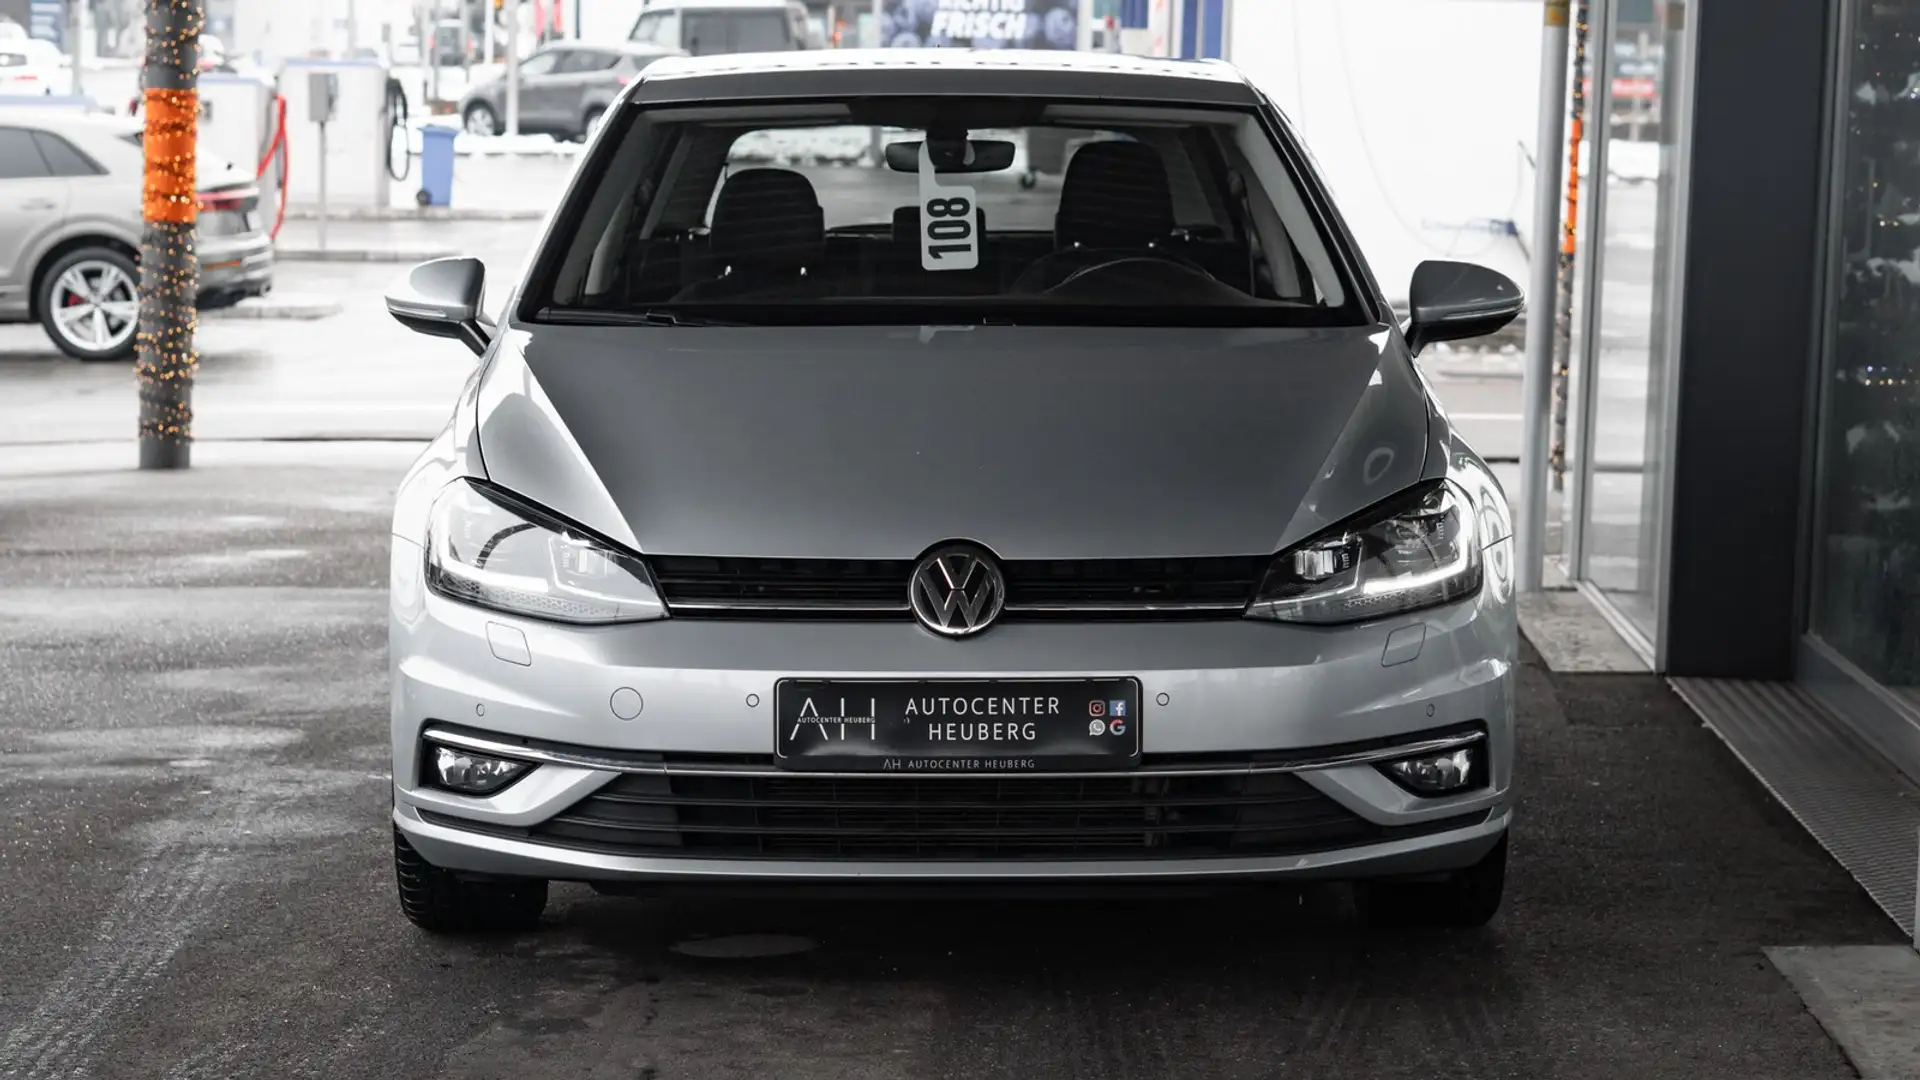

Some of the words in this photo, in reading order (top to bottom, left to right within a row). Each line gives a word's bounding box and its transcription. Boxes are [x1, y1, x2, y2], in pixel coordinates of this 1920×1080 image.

[931, 11, 1027, 39] FRISCH
[926, 197, 971, 259] 108
[904, 697, 1060, 715] AUTOCENTER
[797, 716, 842, 724] AUTOCENTER
[844, 716, 876, 724] HEUBERG
[928, 722, 1037, 741] HEUBERG
[908, 759, 980, 769] AUTOCENTER
[984, 759, 1036, 769] HEUBERG
